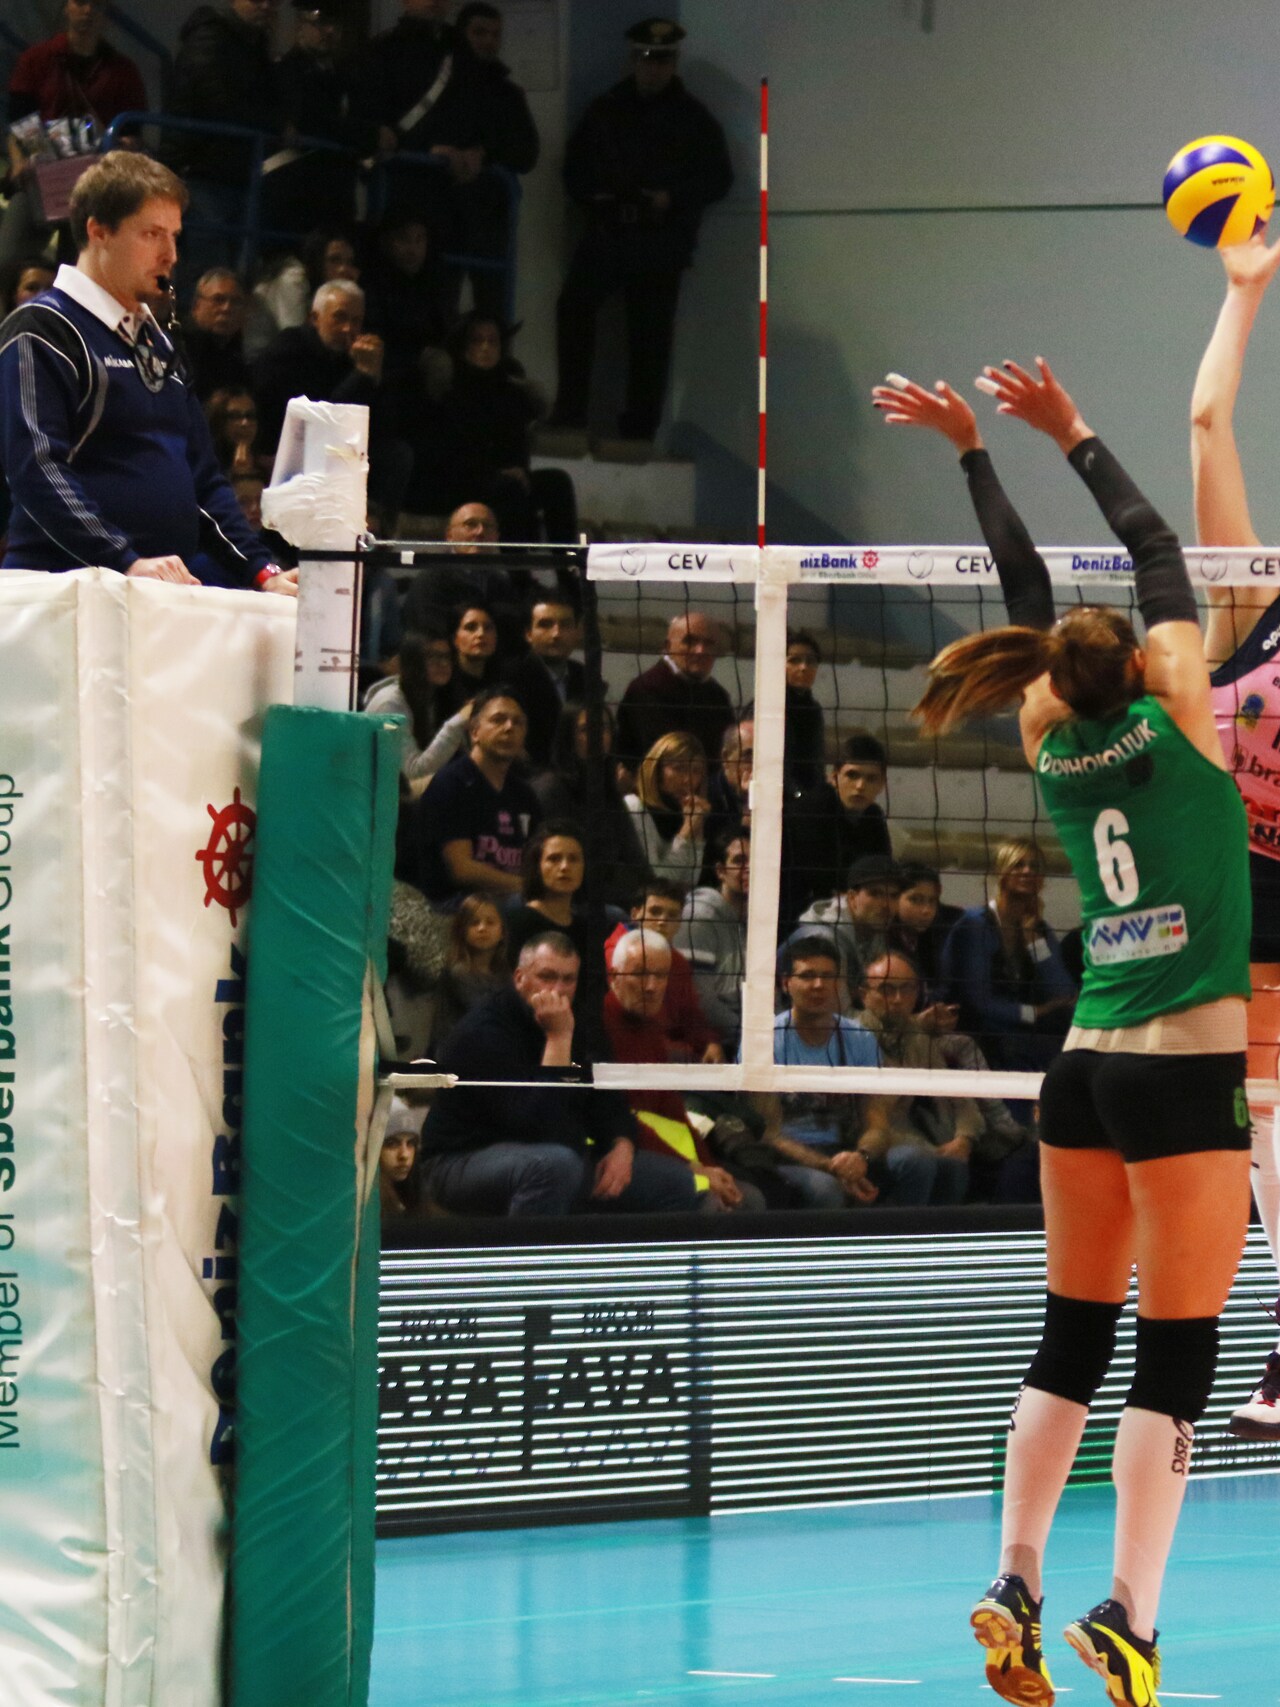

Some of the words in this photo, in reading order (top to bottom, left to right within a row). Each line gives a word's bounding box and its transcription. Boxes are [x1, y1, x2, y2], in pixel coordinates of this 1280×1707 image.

[668, 553, 708, 570] CEV
[800, 553, 857, 568] nizBank
[955, 555, 995, 573] CEV
[1072, 555, 1136, 570] DenizBa
[1093, 808, 1139, 907] 6
[378, 1355, 502, 1424] AVA
